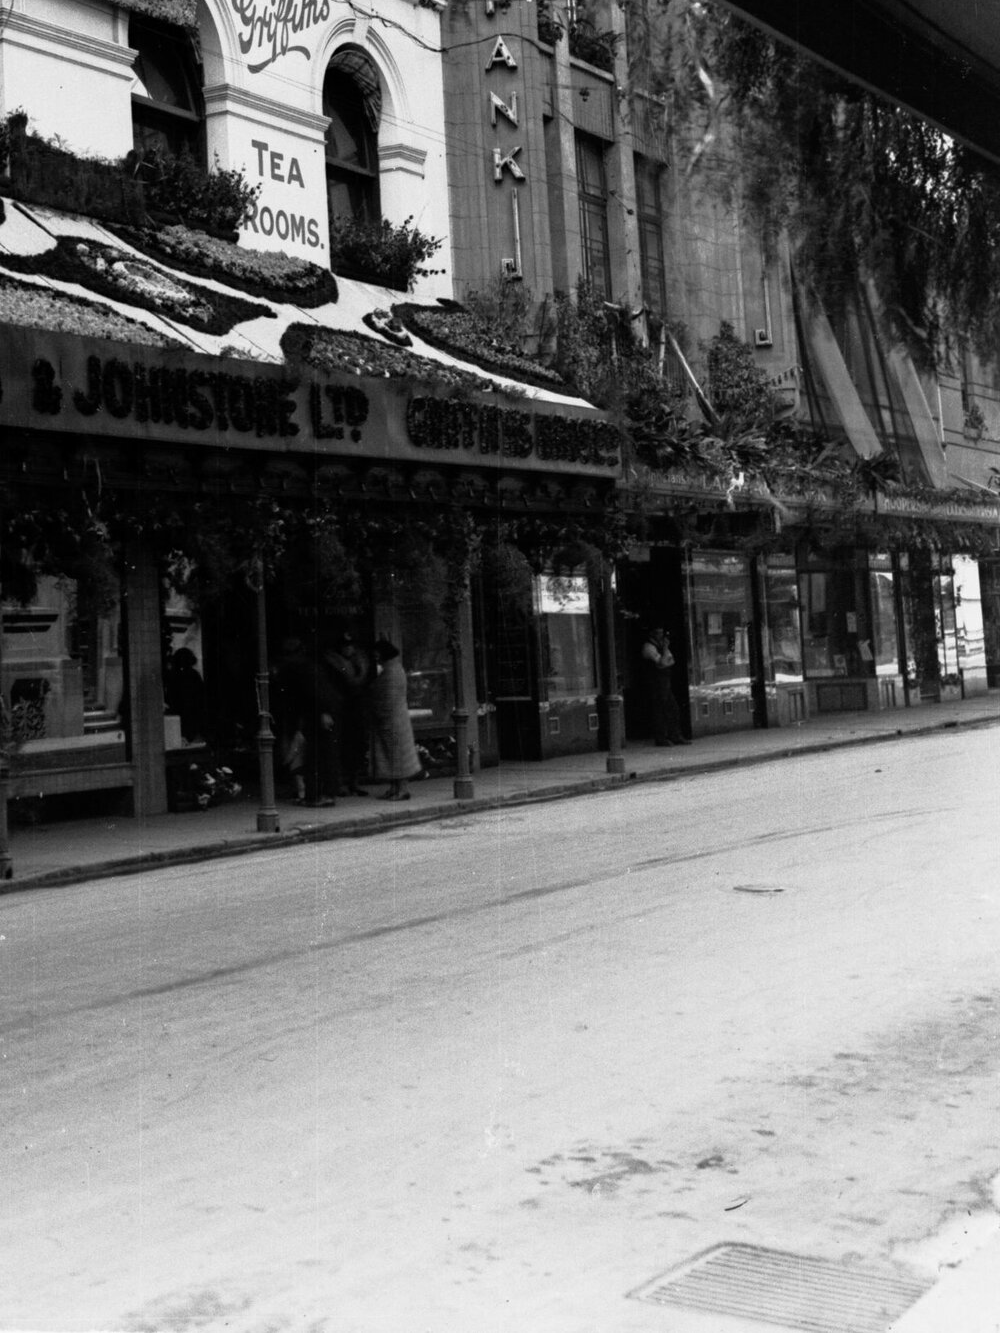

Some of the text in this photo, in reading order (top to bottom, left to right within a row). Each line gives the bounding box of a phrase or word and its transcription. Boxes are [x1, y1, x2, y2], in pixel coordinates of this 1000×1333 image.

[251, 139, 305, 189] TEA
[32, 358, 62, 415] &
[72, 355, 299, 438] JOHNSTONE
